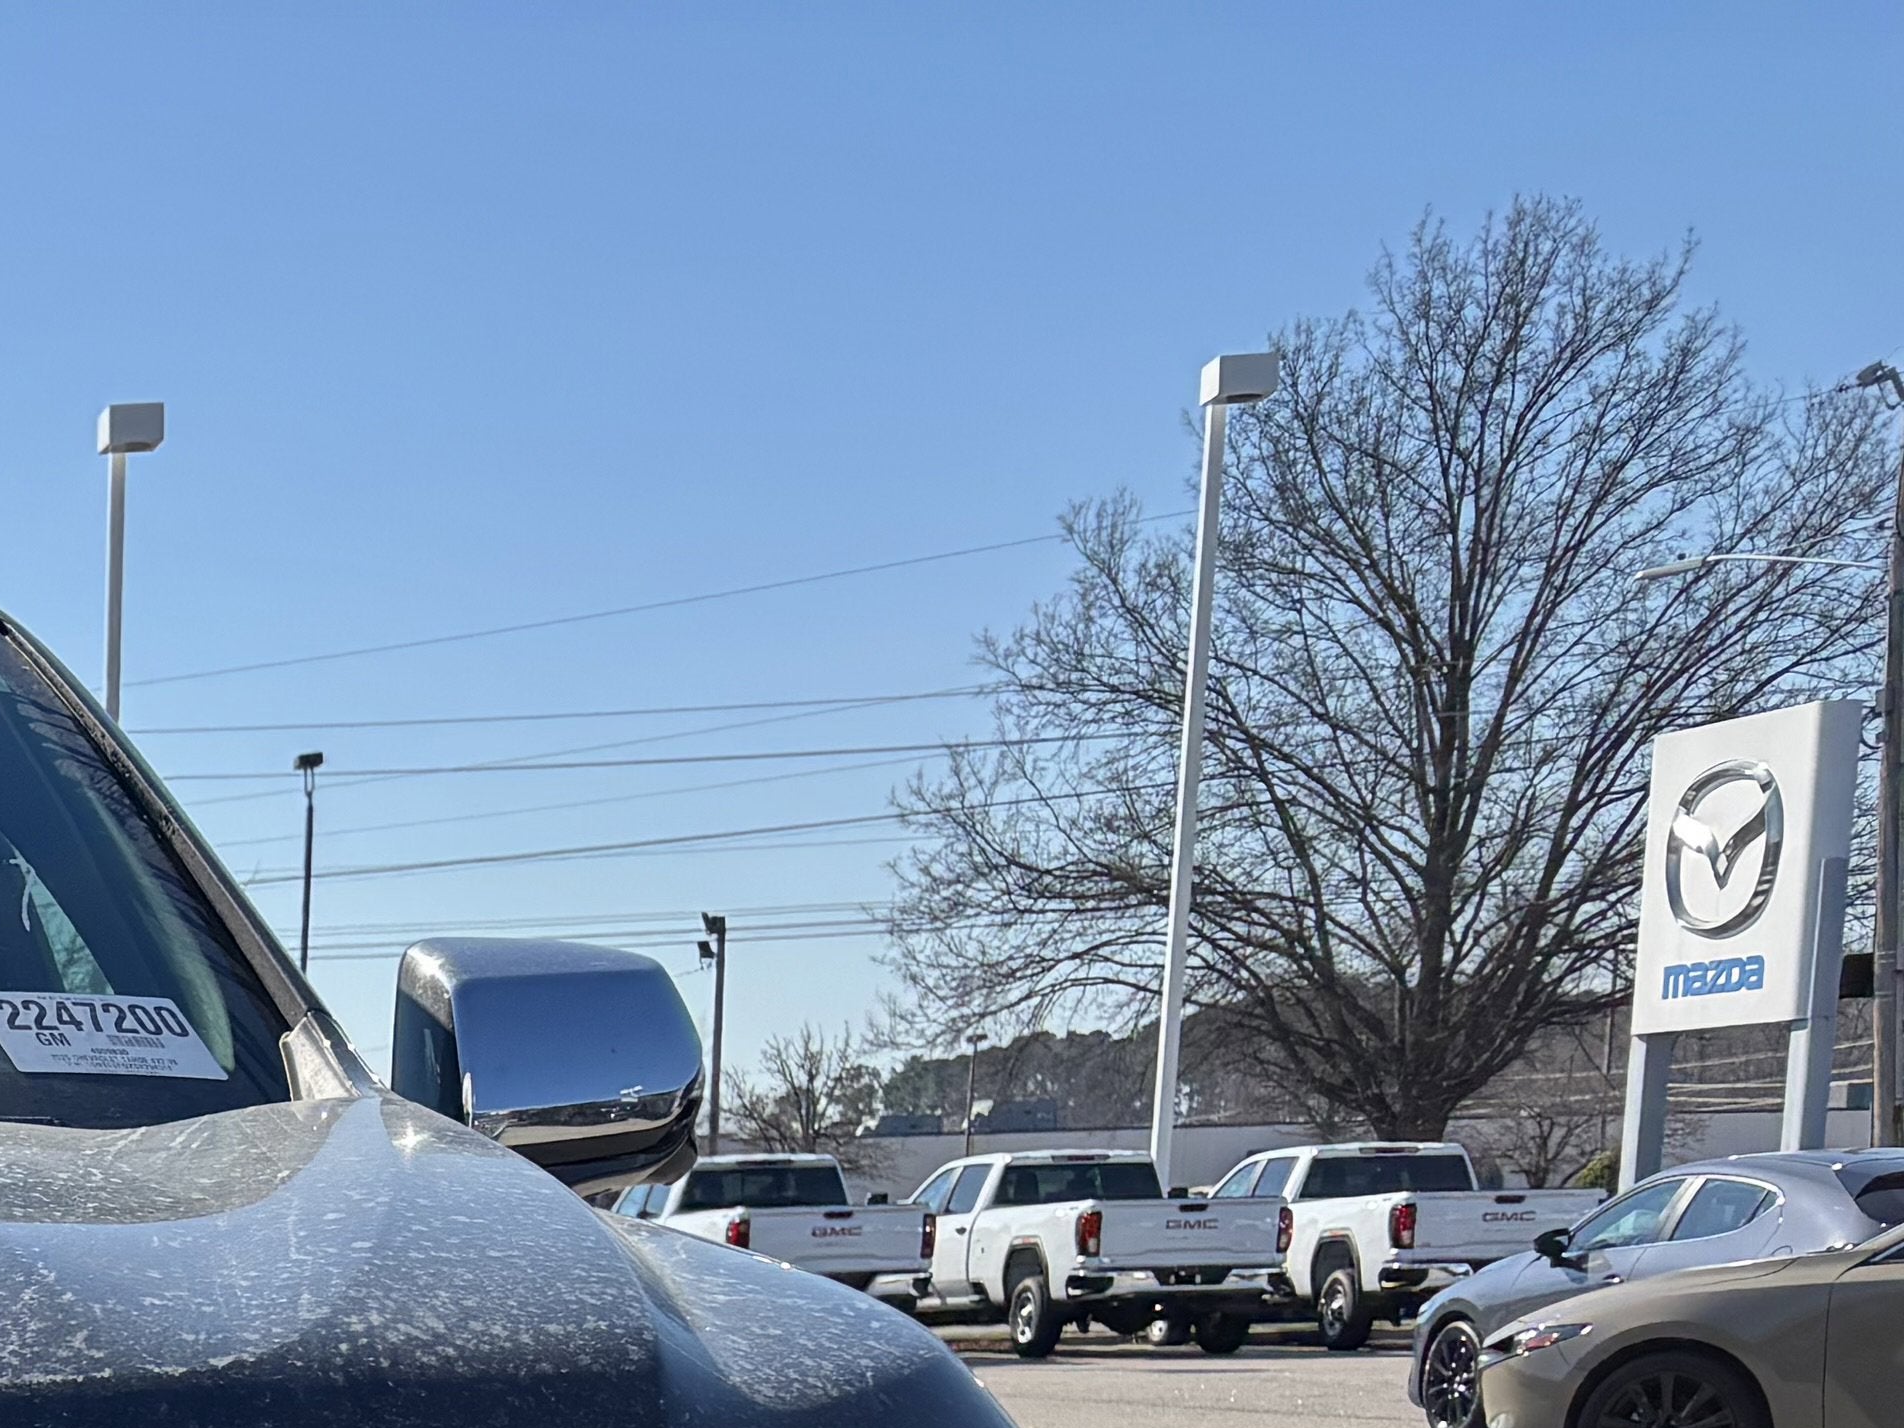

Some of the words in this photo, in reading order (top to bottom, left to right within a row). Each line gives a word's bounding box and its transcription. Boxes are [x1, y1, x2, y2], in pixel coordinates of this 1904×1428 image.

[34, 1031, 72, 1047] GM
[1481, 1210, 1537, 1223] GMC
[1165, 1218, 1219, 1230] GMC
[811, 1226, 863, 1237] GMC
